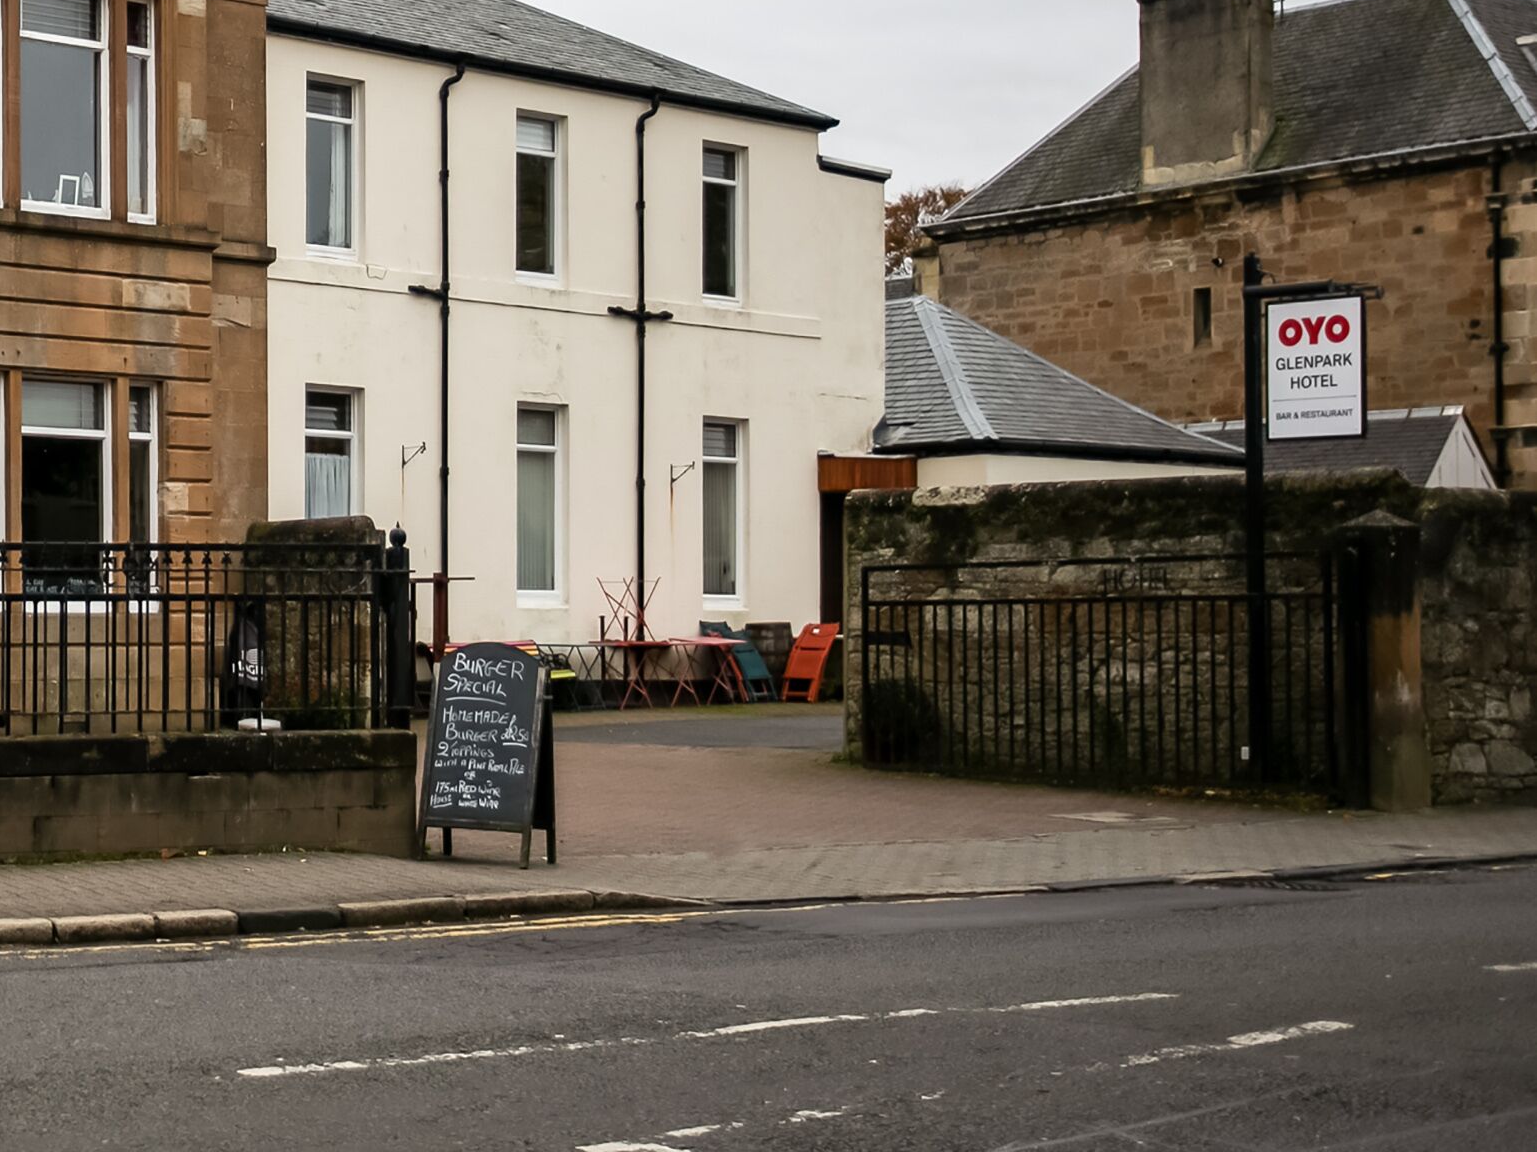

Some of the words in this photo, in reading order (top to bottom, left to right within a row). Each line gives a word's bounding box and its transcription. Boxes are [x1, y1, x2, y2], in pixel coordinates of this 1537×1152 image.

[1278, 314, 1350, 347] OYO
[1275, 352, 1352, 371] GLENPARK
[1290, 374, 1338, 389] HOTEL
[1275, 412, 1292, 421] BAR
[1292, 411, 1299, 419] &
[1301, 408, 1353, 419] RESTAURANT
[452, 652, 524, 680] BURGER
[443, 673, 507, 696] SPECIAL
[442, 705, 510, 724] HOMEMADE
[445, 722, 498, 743] BURGER
[436, 741, 449, 757] 2
